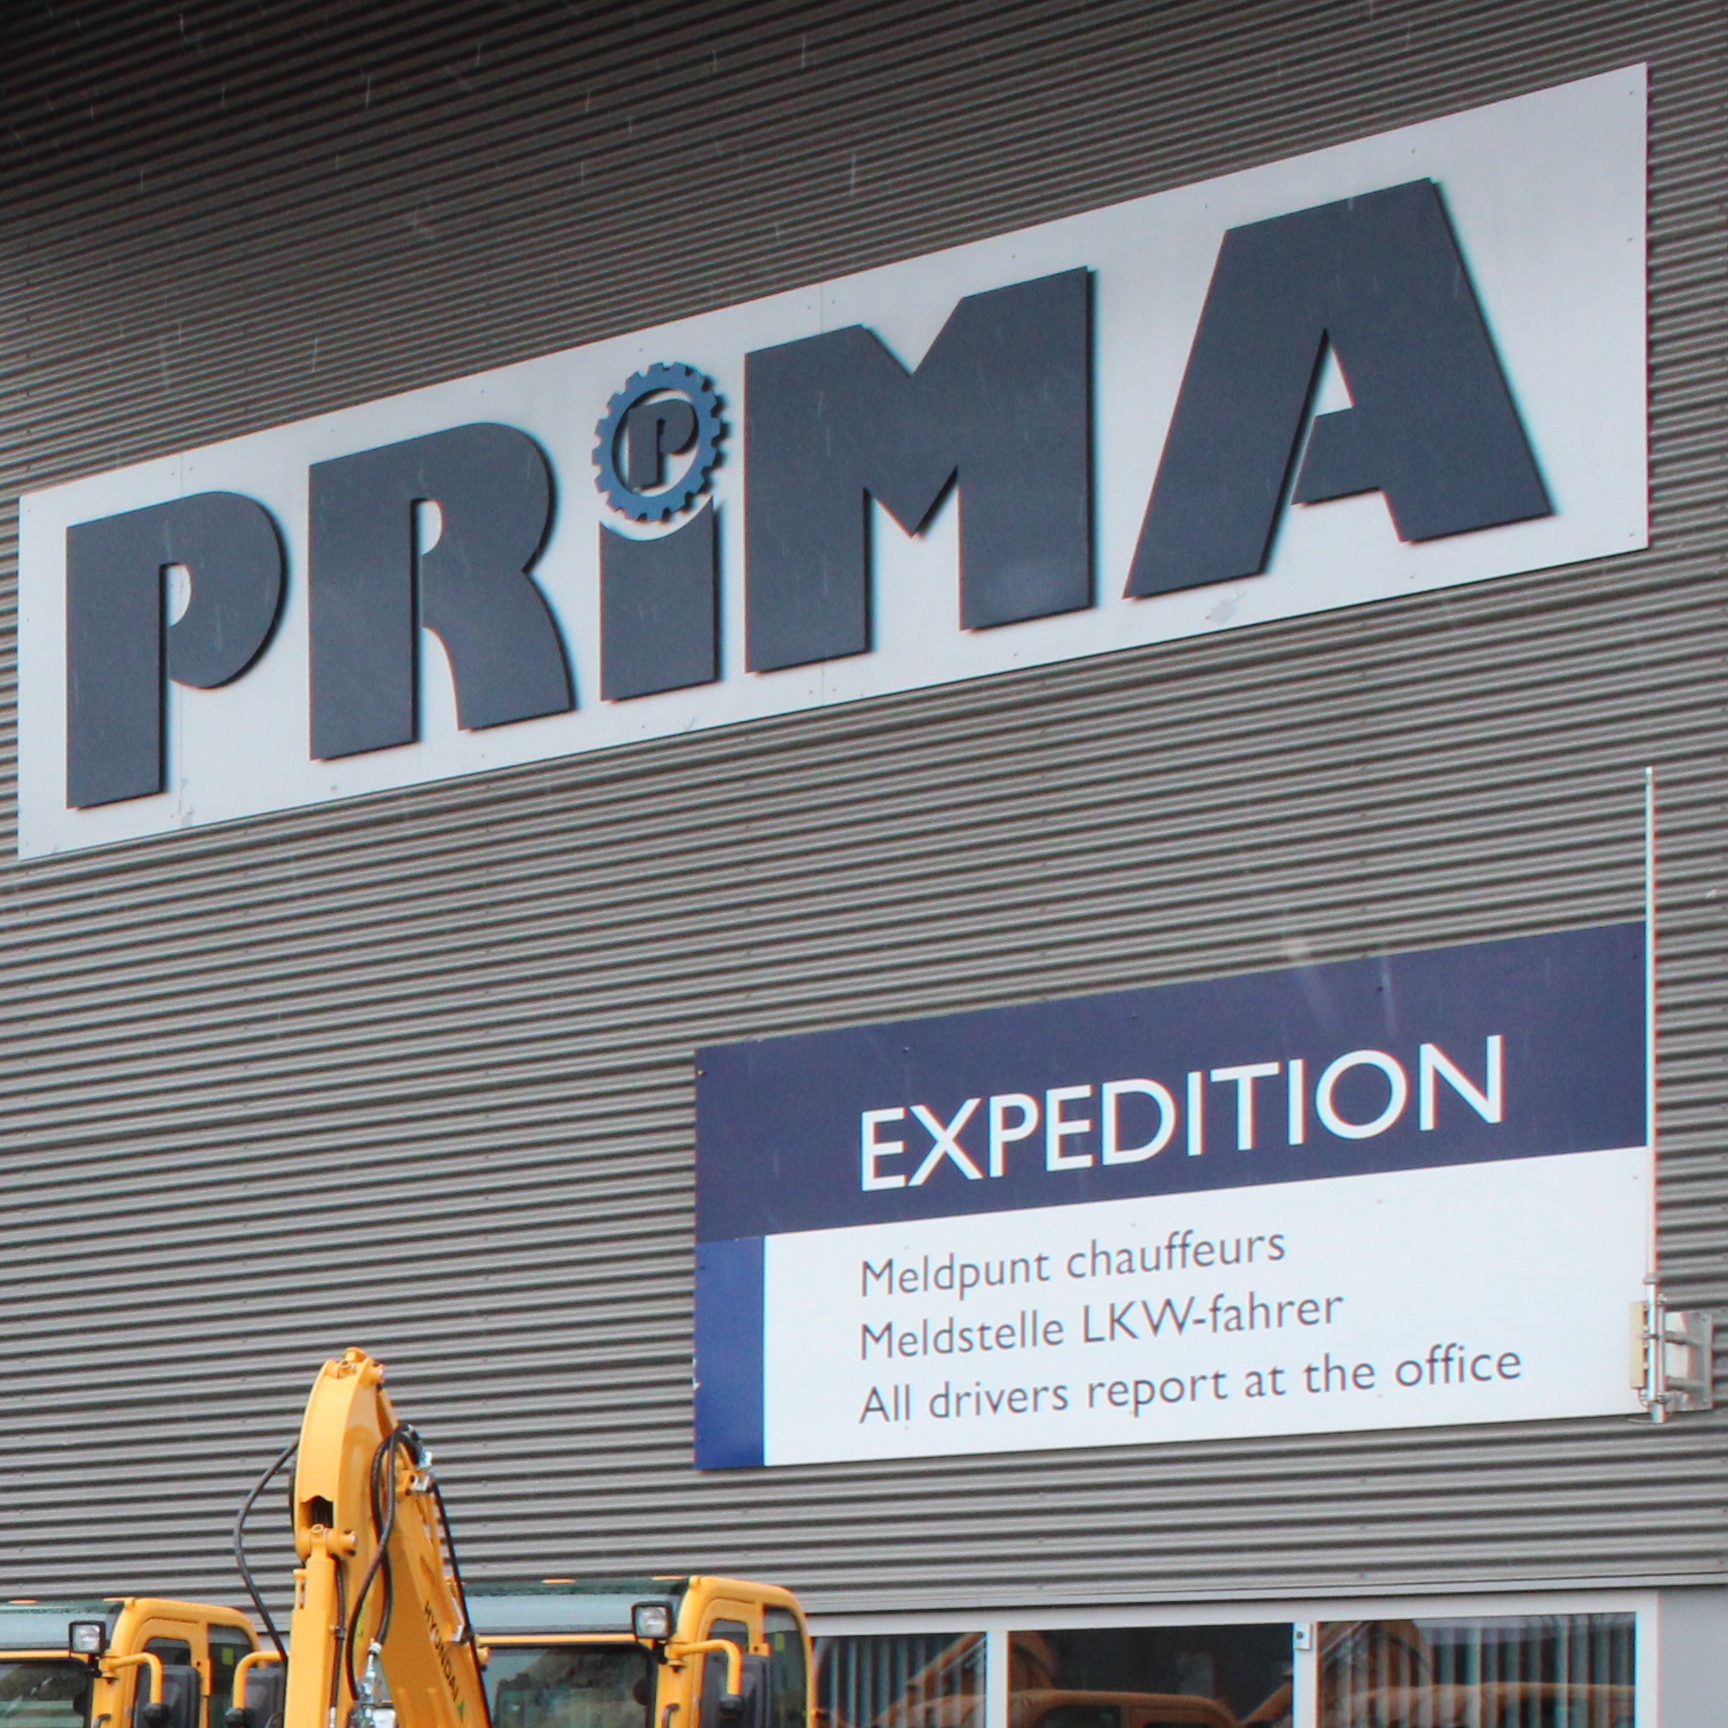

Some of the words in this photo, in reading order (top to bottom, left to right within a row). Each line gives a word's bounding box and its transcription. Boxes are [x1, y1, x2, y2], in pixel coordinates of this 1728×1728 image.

[860, 1034, 1505, 1192] EXPEDITION
[860, 1252, 1051, 1301] Meldpunt
[1066, 1229, 1286, 1278] chauffeurs
[860, 1309, 1065, 1361] Meldstelle
[1083, 1291, 1345, 1344] LKW-fahrer
[858, 1383, 911, 1424] All
[928, 1380, 1069, 1419] drivers
[1088, 1369, 1229, 1418] report
[1244, 1364, 1287, 1398] at
[1302, 1352, 1376, 1394] the
[1395, 1342, 1522, 1388] office
